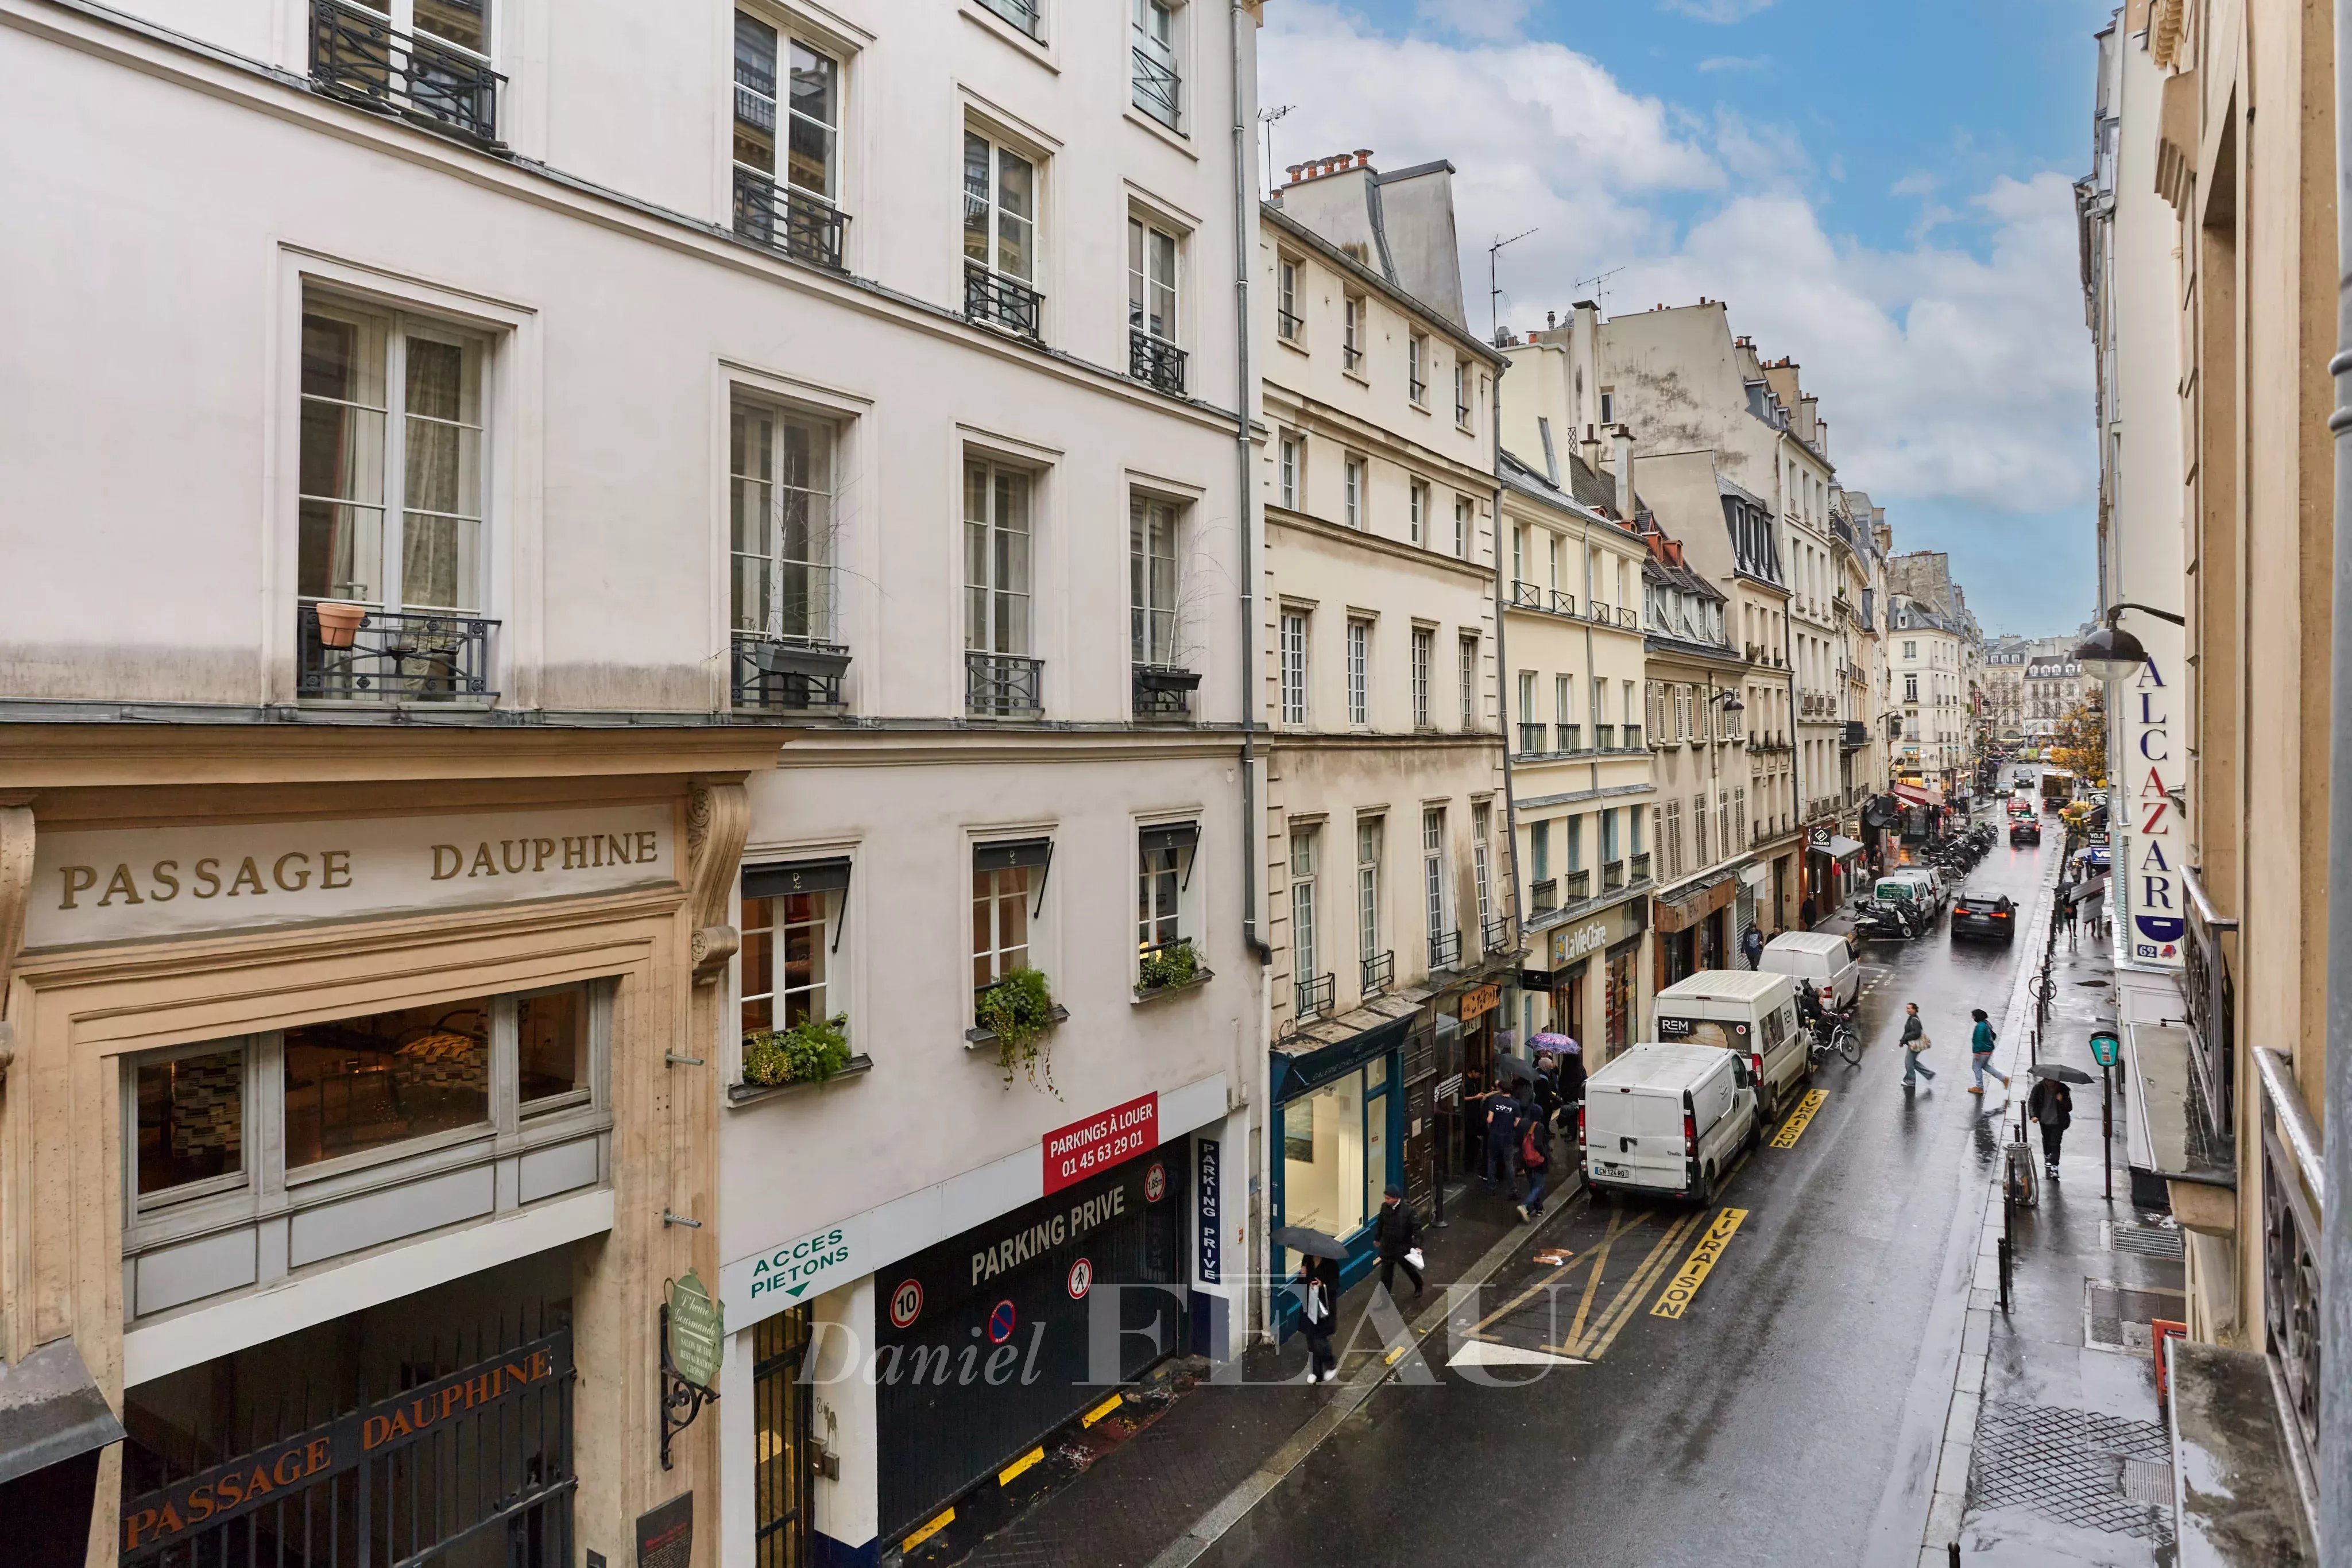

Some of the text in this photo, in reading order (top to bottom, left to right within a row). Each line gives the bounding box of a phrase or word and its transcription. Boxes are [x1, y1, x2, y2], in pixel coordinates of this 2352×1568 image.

[2136, 656, 2173, 909] ALCAZAR
[59, 830, 659, 910] PASSAGE DAUPHINE
[1565, 921, 1606, 961] La Vie Claire
[2139, 946, 2155, 957] 62
[1662, 1020, 1688, 1031] REM
[1050, 1103, 1153, 1158] PARKINGS À LOUER
[1062, 1129, 1143, 1178] 01 45 63 29 01
[972, 1184, 1124, 1286] PARKING PRIVE
[1202, 1143, 1216, 1280] PARKING PRIVE
[751, 1246, 849, 1299] PIETONS
[753, 1229, 843, 1277] ACCES
[1655, 1209, 1738, 1316] LIVRAISON
[674, 1307, 716, 1337] Gourmande
[681, 1292, 710, 1317] L'heure
[897, 1290, 917, 1317] 10
[680, 1337, 695, 1350] SALON
[680, 1349, 713, 1370] RESTAURATION
[687, 1364, 705, 1379] CHOISIE
[124, 1345, 552, 1551] PASSAGE DAUPHINE
